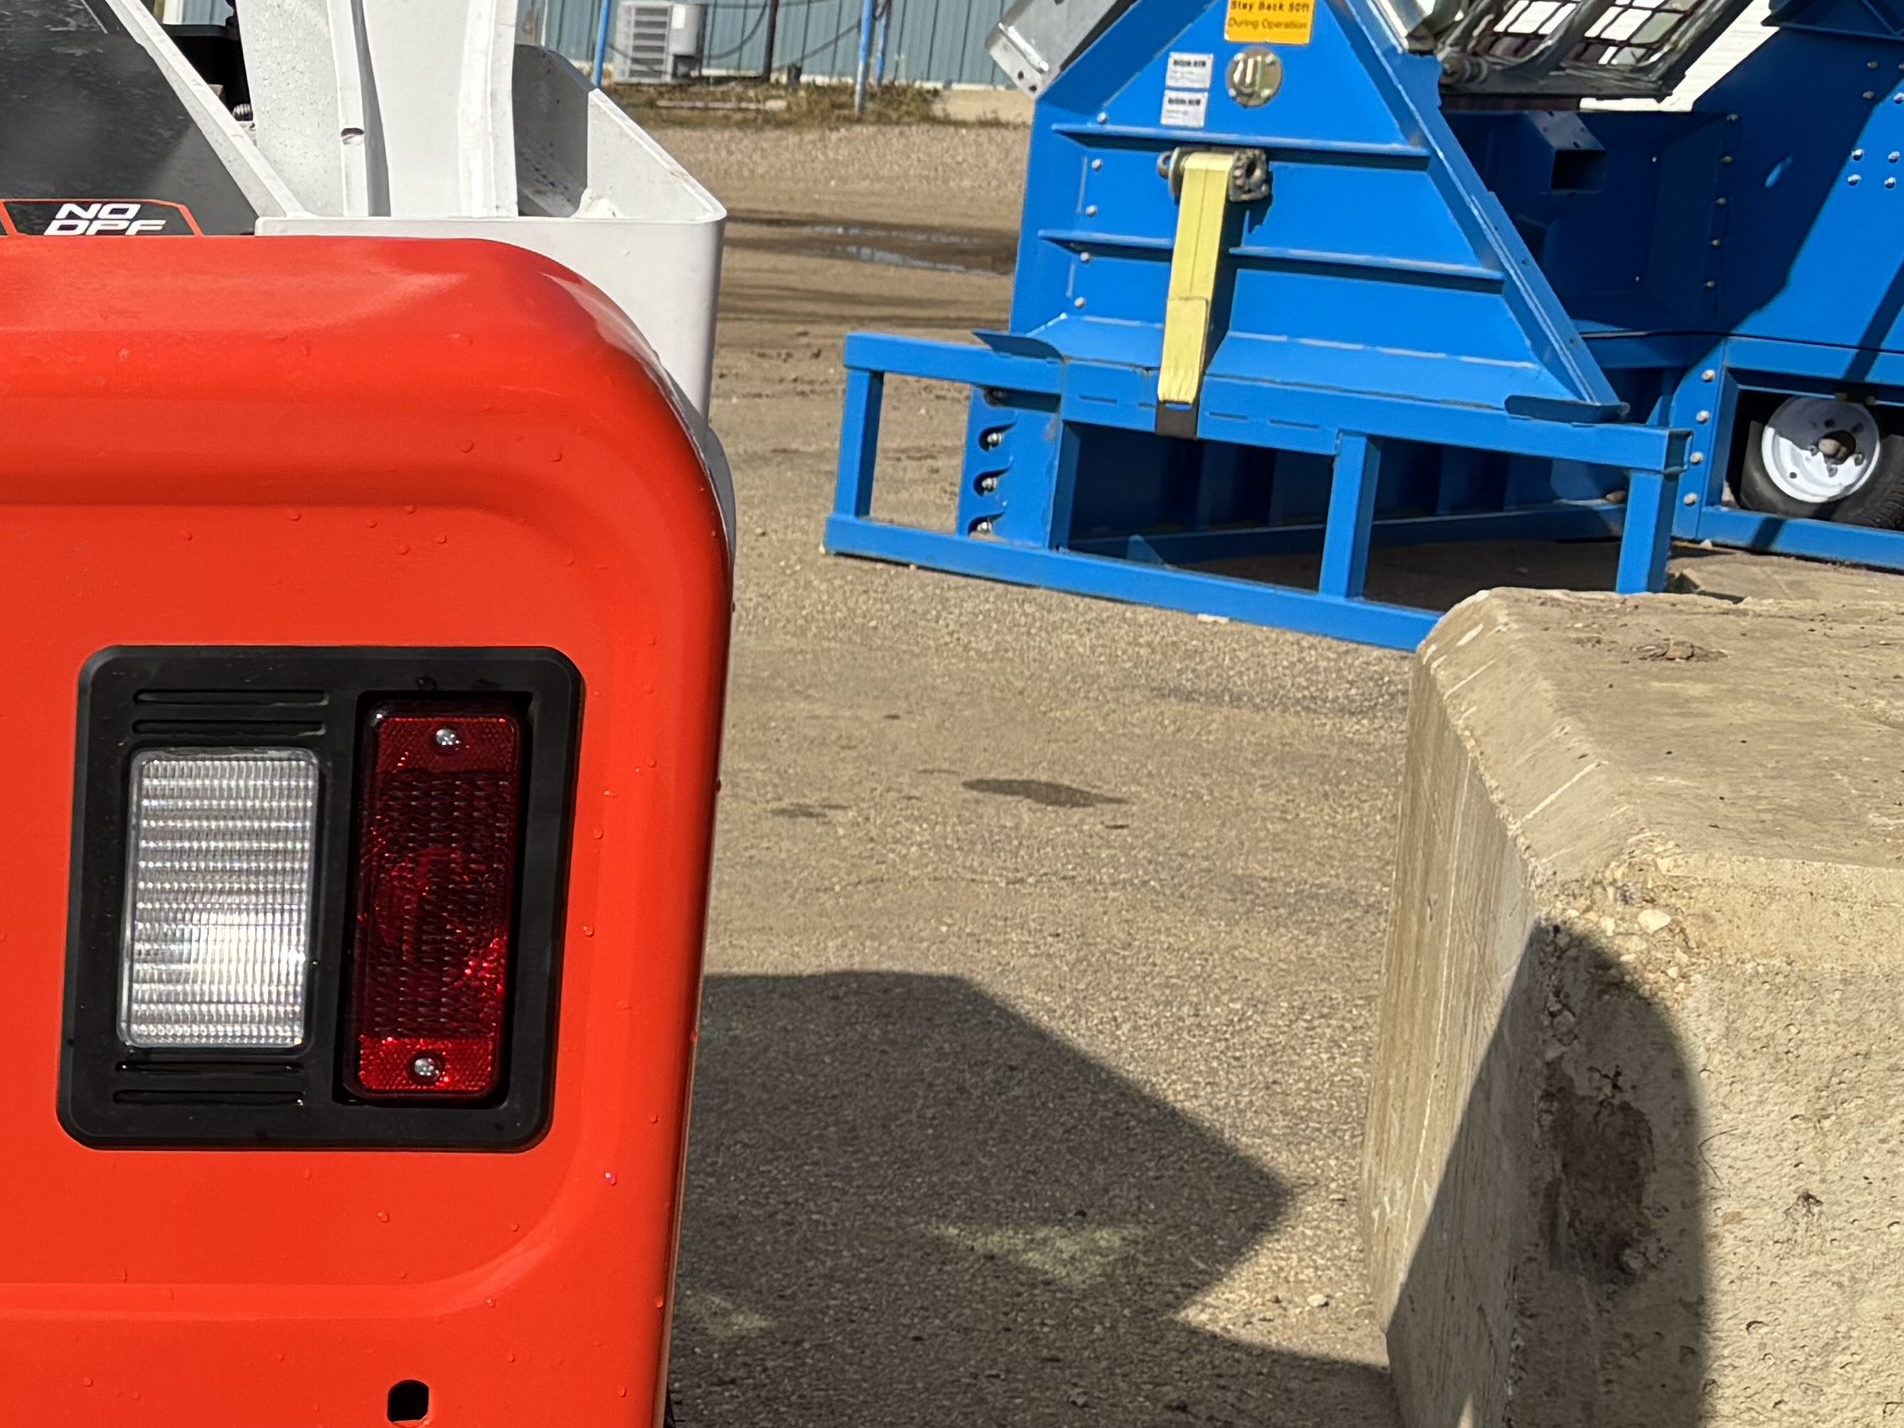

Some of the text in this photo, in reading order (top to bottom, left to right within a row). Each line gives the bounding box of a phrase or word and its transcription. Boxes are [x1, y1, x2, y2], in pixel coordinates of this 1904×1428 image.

[1231, 0, 1254, 12] Stay
[1258, 1, 1284, 12] Back
[1228, 17, 1308, 30] During Operation
[55, 203, 142, 220] NO
[43, 220, 167, 236] DPF
